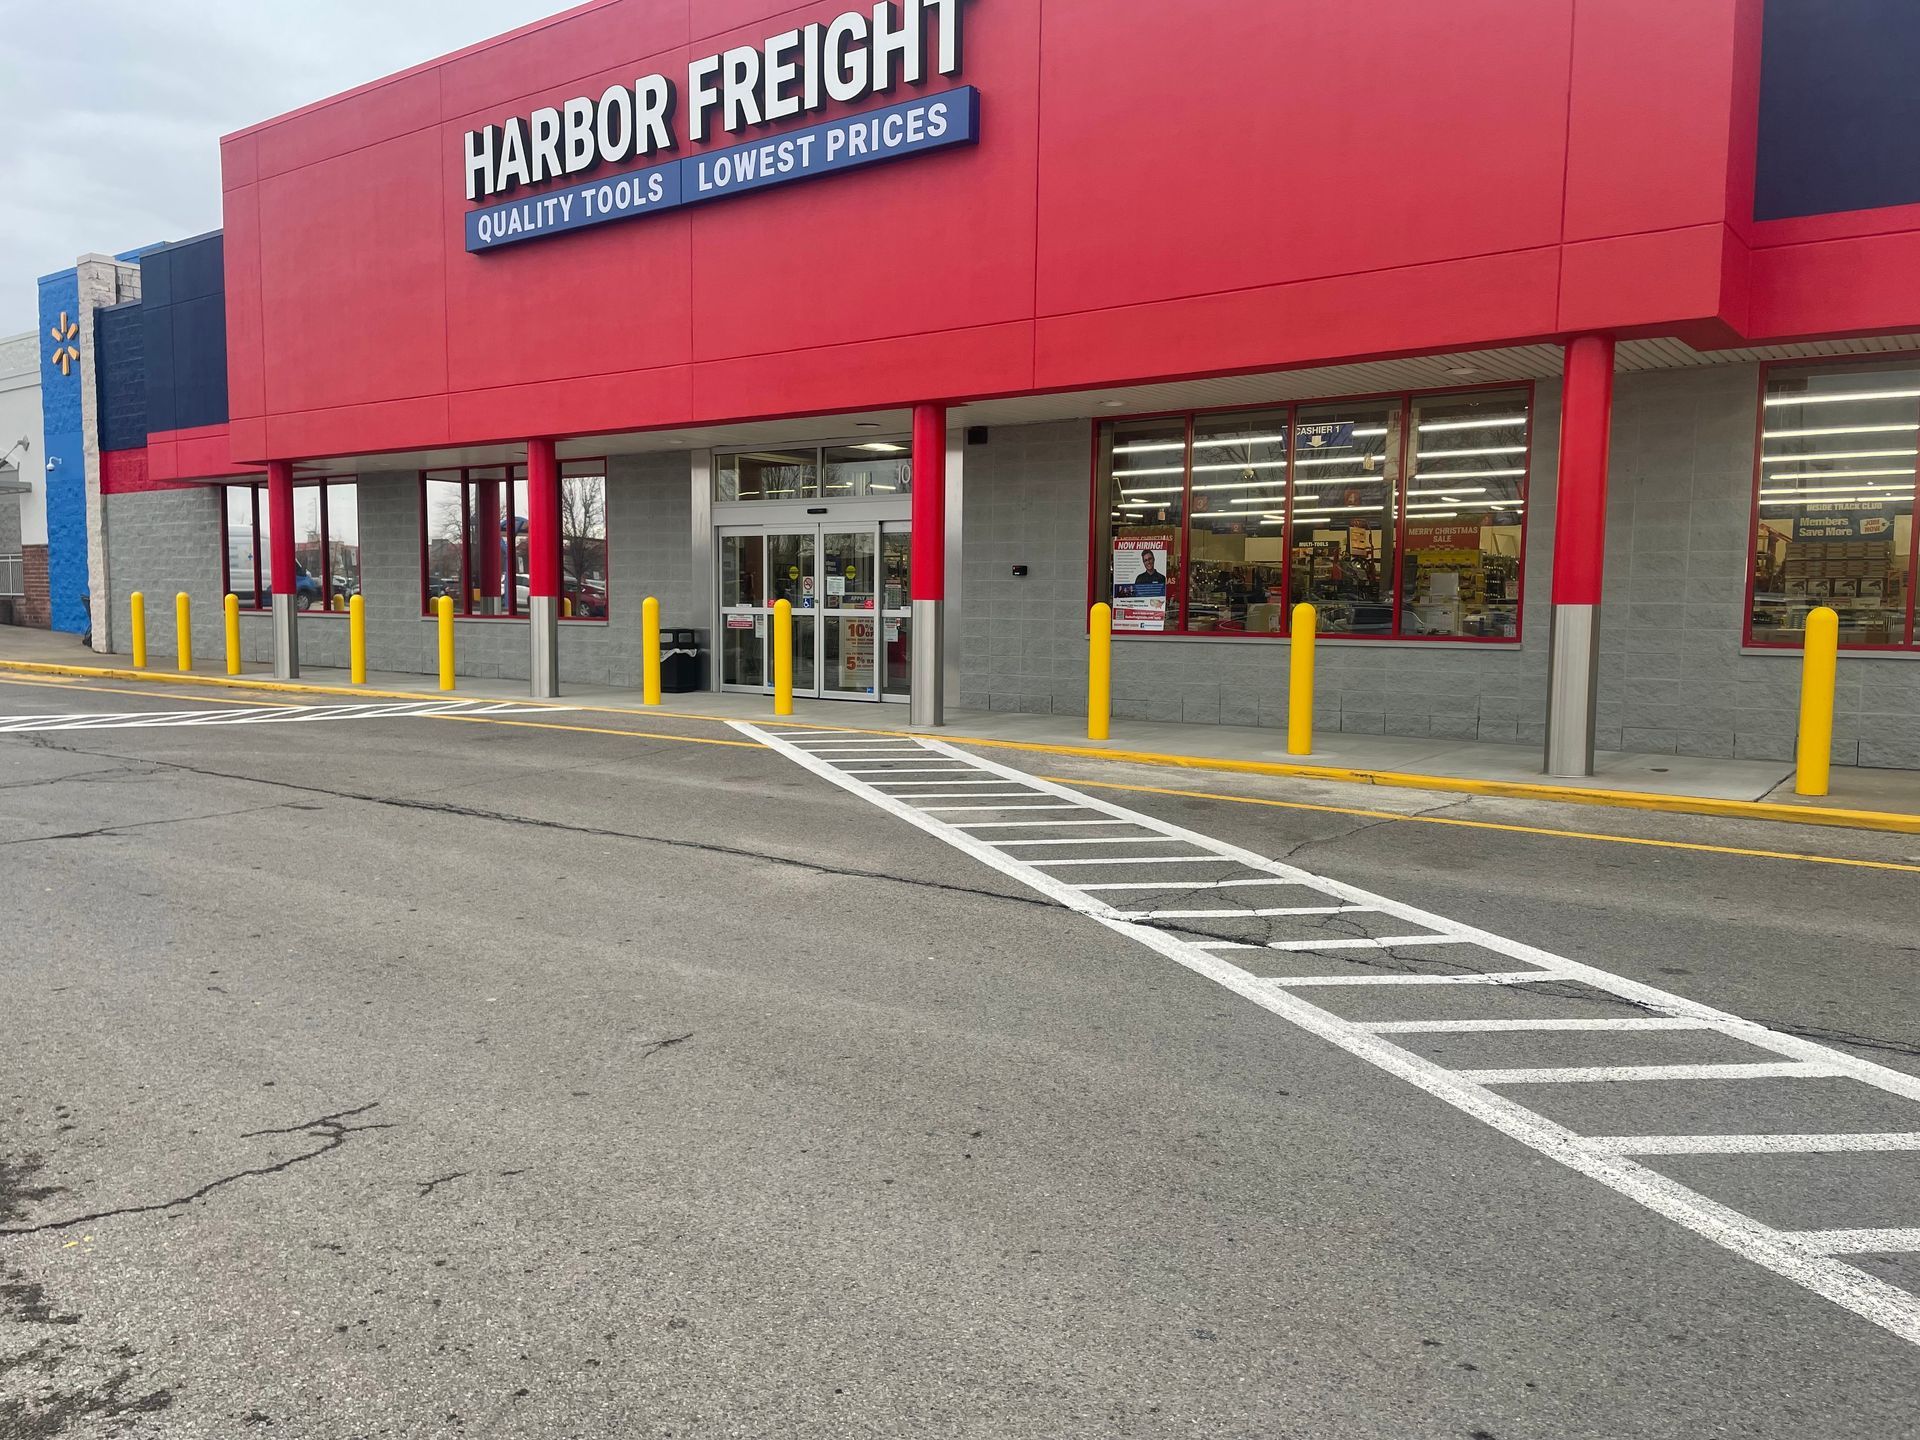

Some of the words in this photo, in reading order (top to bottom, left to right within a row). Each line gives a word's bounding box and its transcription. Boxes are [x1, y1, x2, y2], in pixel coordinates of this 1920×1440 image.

[464, 73, 672, 201] HARBOR
[688, 0, 960, 142] FREIGHT
[697, 135, 816, 192] LOWEST
[826, 102, 948, 162] PRICES
[477, 194, 574, 244] QUALITY
[580, 172, 664, 214] TOOLS
[1335, 425, 1340, 433] 1
[1834, 502, 1861, 511] TRACK
[1800, 517, 1849, 527] Members
[1408, 527, 1433, 536] MERRY
[1435, 526, 1478, 535] CHRISTMAS
[1799, 528, 1824, 537] Save
[1825, 527, 1853, 536] More
[1433, 535, 1452, 543] SALE
[1117, 541, 1136, 550] NOW
[1136, 541, 1164, 550] HIRING!
